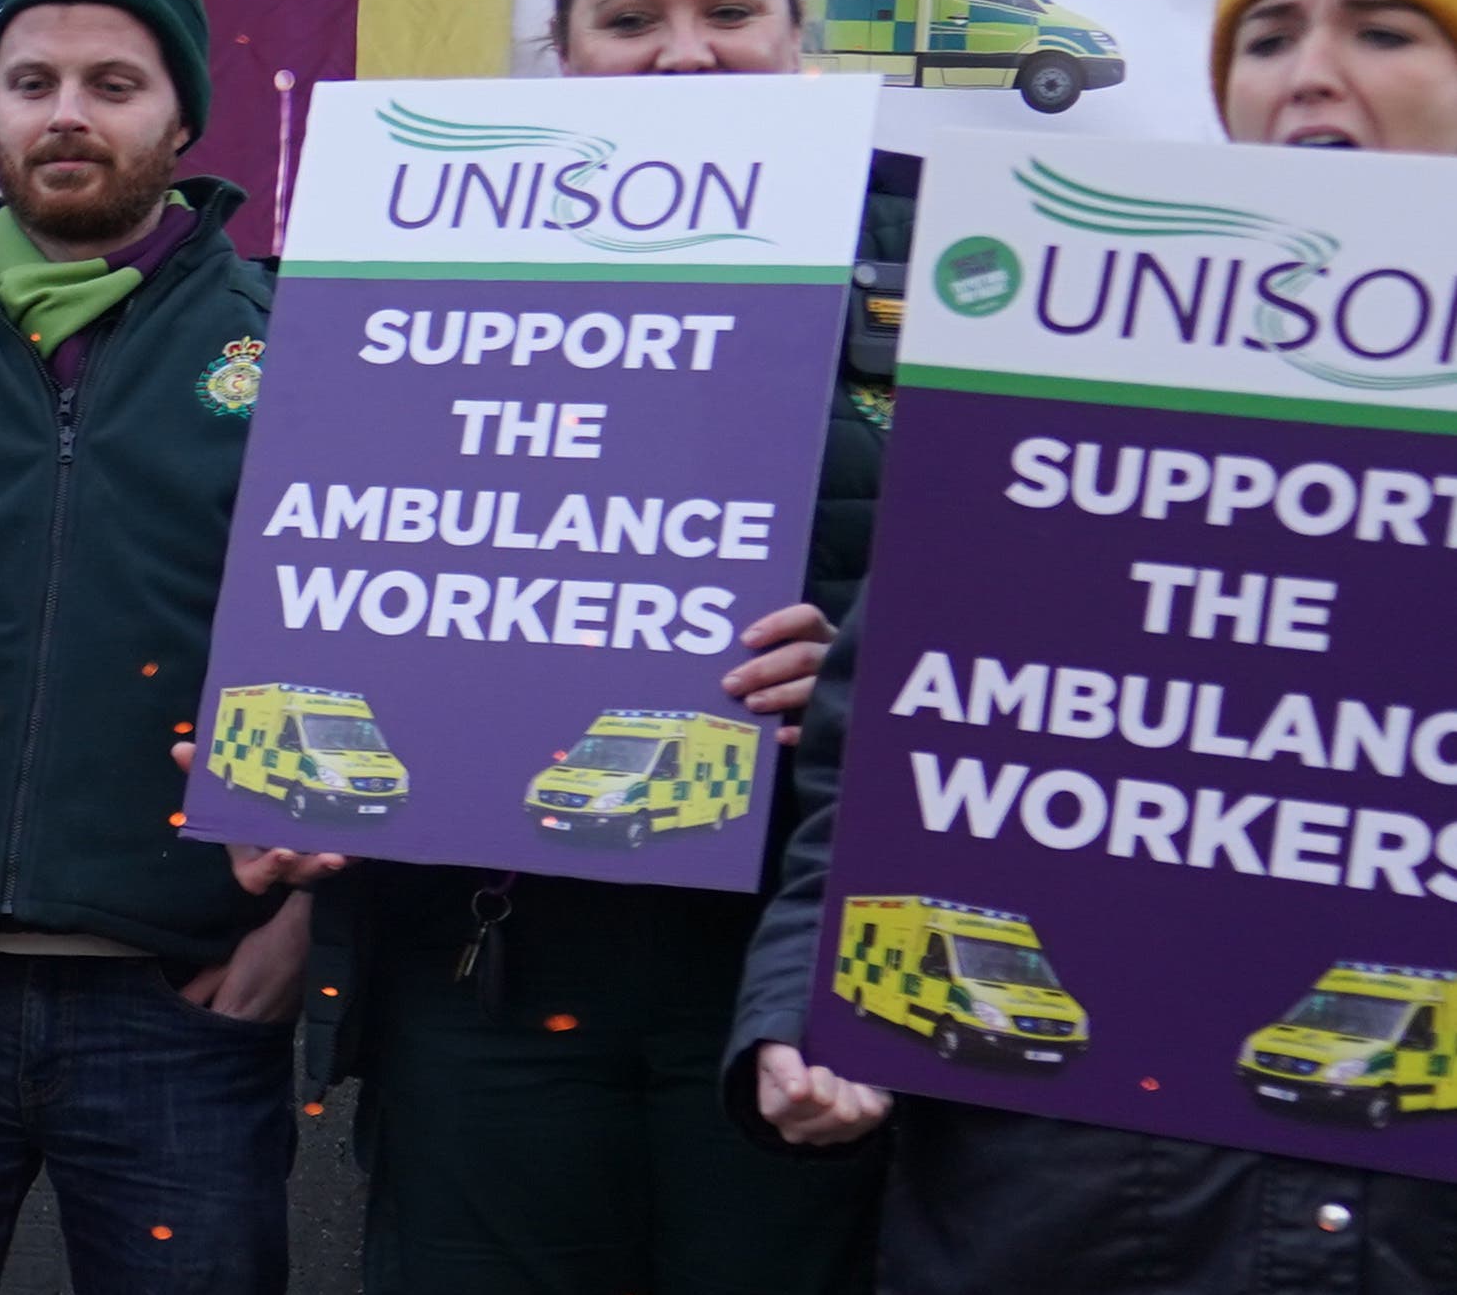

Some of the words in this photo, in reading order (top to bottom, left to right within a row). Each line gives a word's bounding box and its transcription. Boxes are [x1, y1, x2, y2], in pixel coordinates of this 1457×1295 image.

[387, 160, 762, 231] UNISON
[358, 309, 734, 370] SUPPORT
[451, 399, 608, 459] THE
[263, 482, 776, 560] AMBULANCE
[275, 565, 734, 655] WORKERS
[1130, 560, 1337, 652] THE
